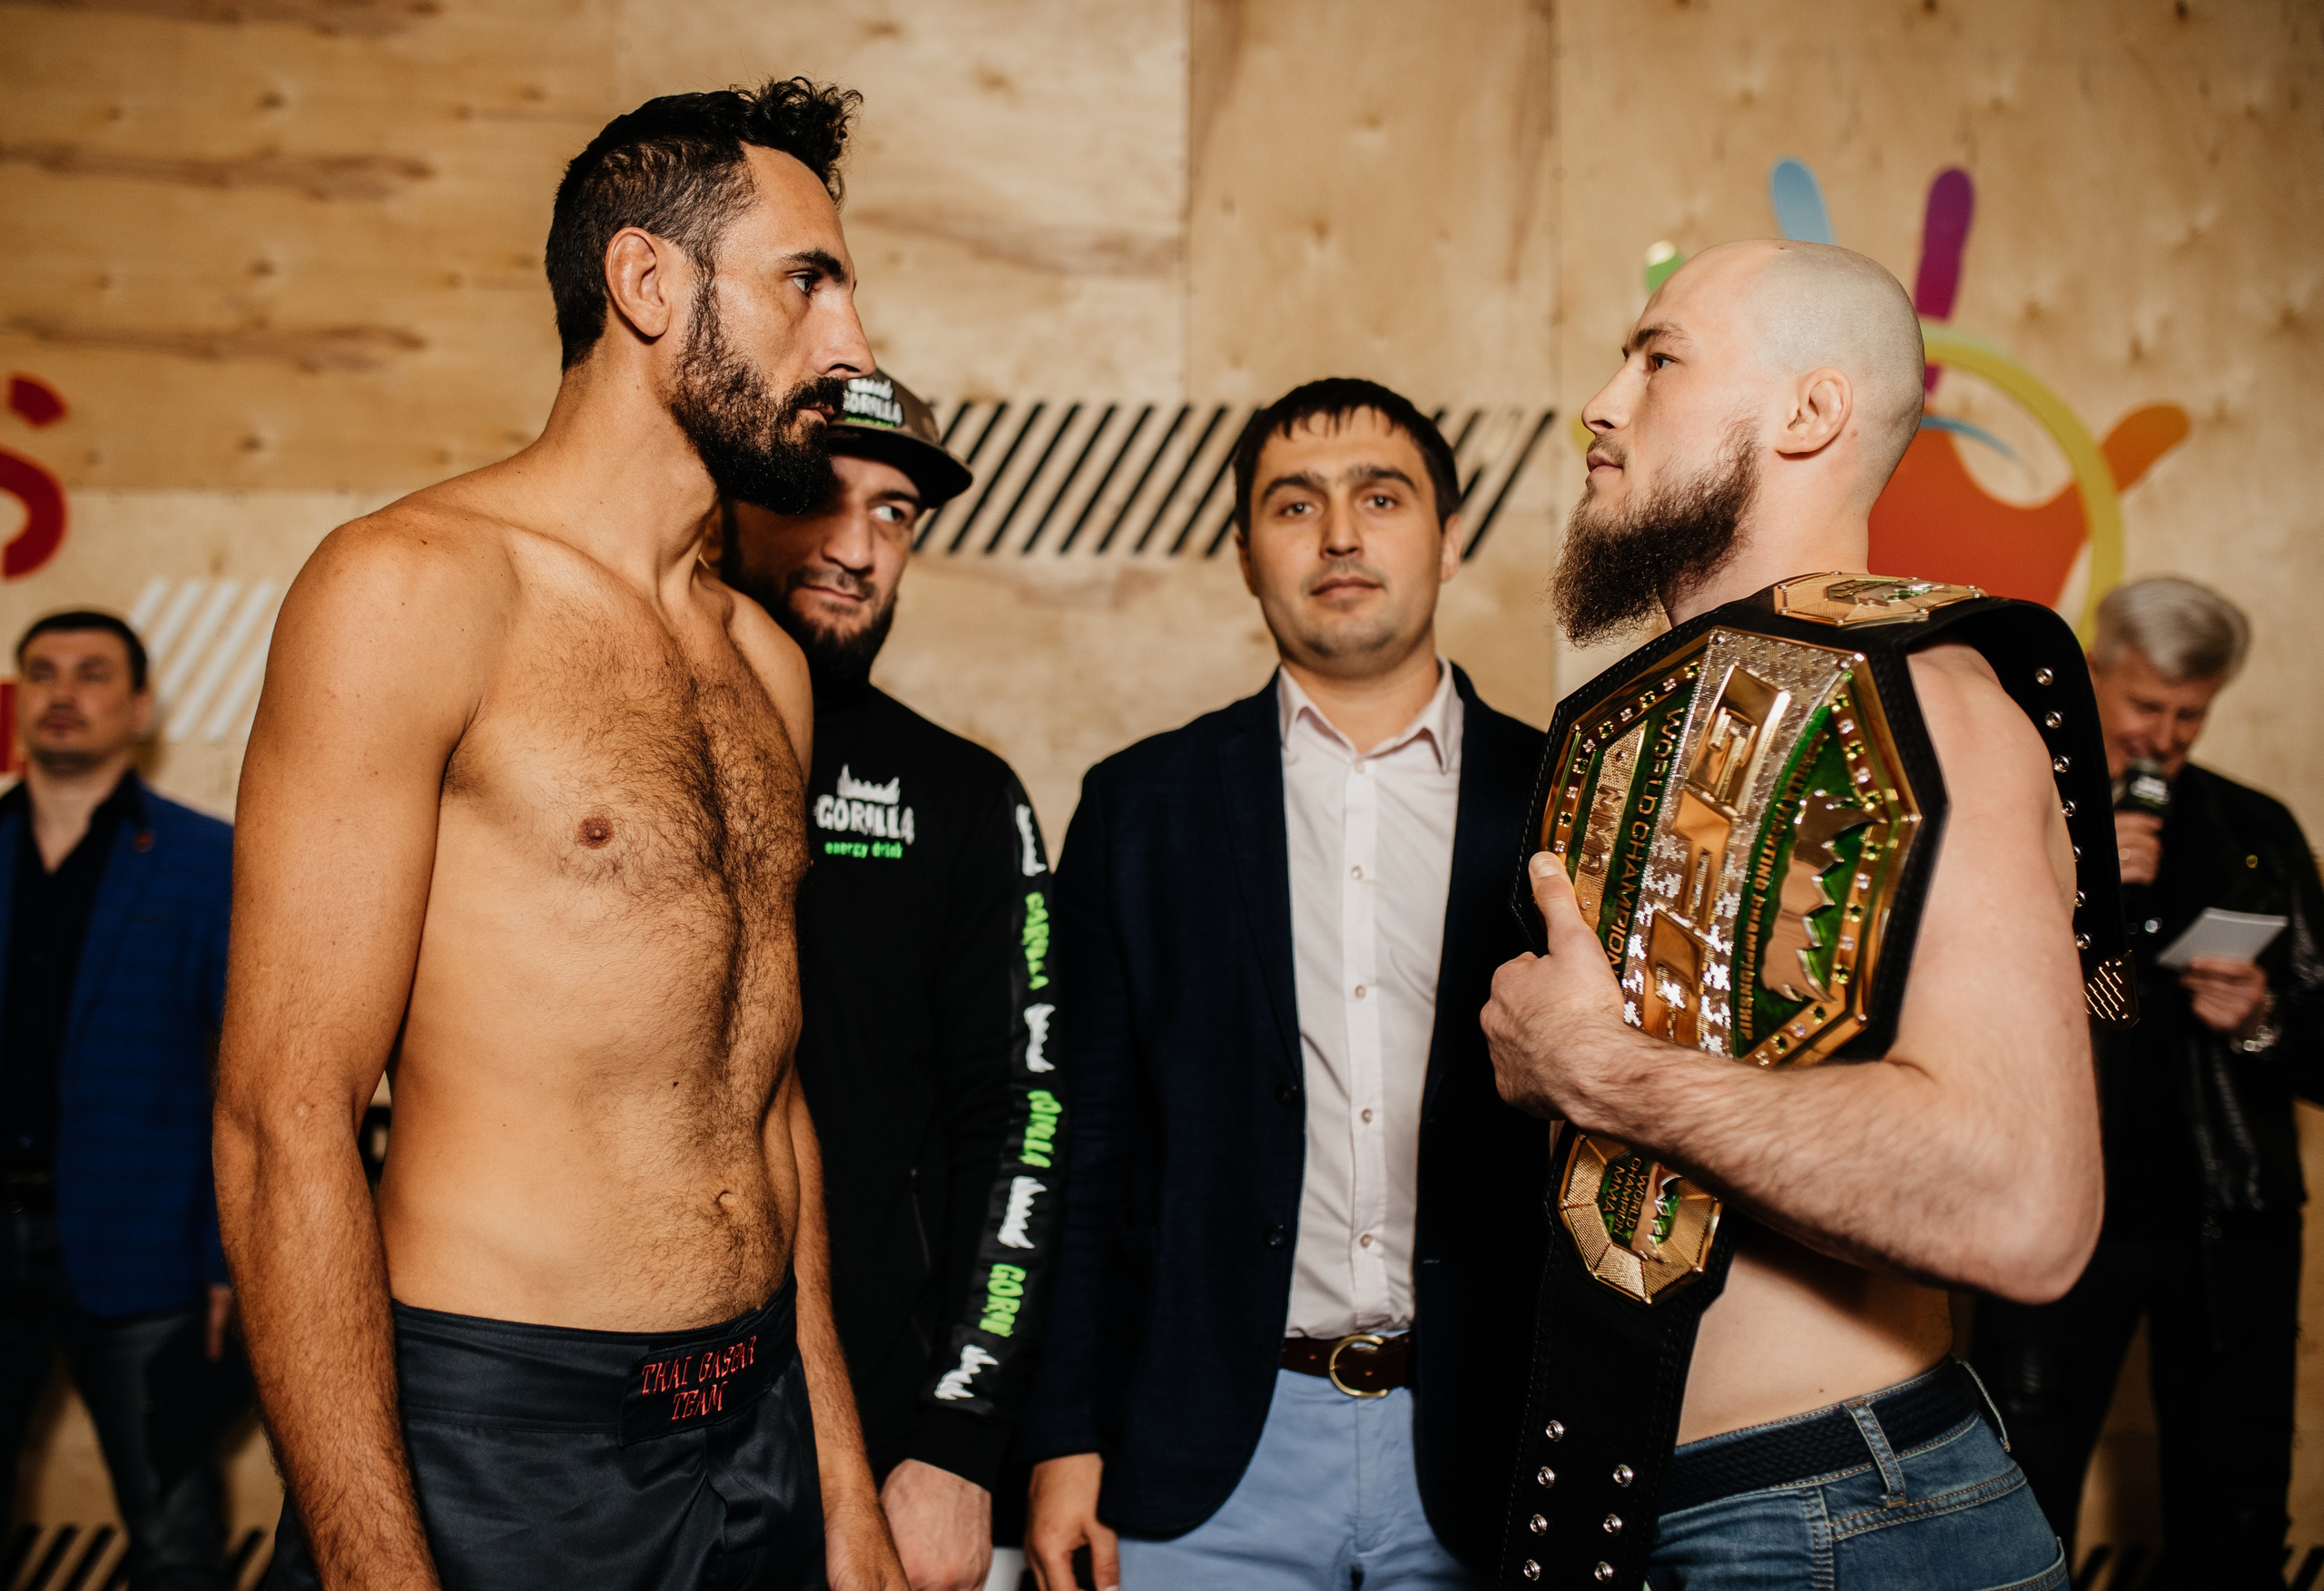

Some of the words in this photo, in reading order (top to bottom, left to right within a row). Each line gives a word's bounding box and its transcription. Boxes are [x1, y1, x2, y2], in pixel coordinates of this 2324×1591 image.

[1642, 707, 1686, 815] WORLD
[815, 794, 915, 846] GORILLA
[824, 841, 869, 859] energy
[872, 840, 903, 859] drink
[1606, 820, 1650, 977] CHAMPION
[1738, 893, 1768, 1041] CHAMPIONSHIP
[1603, 1165, 1626, 1213] MMA
[1614, 1157, 1642, 1235] CHAMPION
[1626, 1175, 1649, 1230] WORLD
[641, 1356, 693, 1396] THAI
[671, 1381, 728, 1421] TEAM
